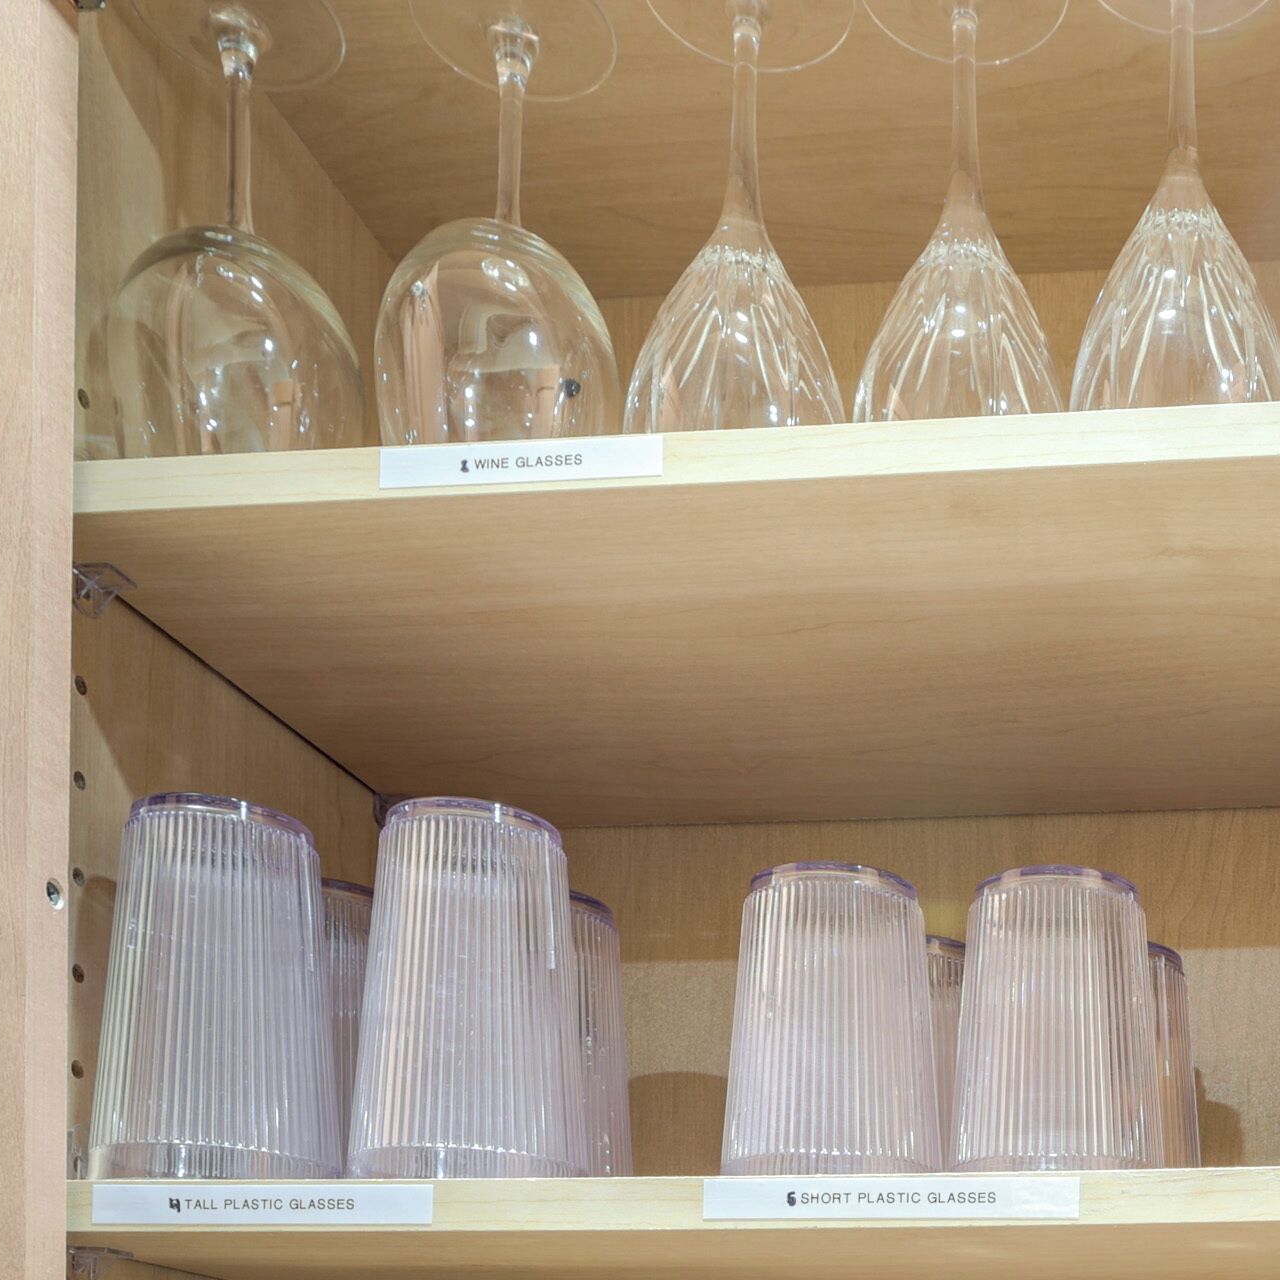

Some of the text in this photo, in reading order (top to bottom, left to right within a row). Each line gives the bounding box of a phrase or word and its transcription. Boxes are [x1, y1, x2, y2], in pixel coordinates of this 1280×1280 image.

[474, 457, 509, 469] WINE
[515, 454, 583, 468] GLASSES
[801, 1193, 851, 1204] SHORT
[858, 1192, 921, 1204] PLASTIC
[927, 1192, 996, 1204] GLASSES
[185, 1199, 218, 1210] TALL
[224, 1199, 283, 1210] PLASTIC
[289, 1199, 355, 1210] GLASSES
